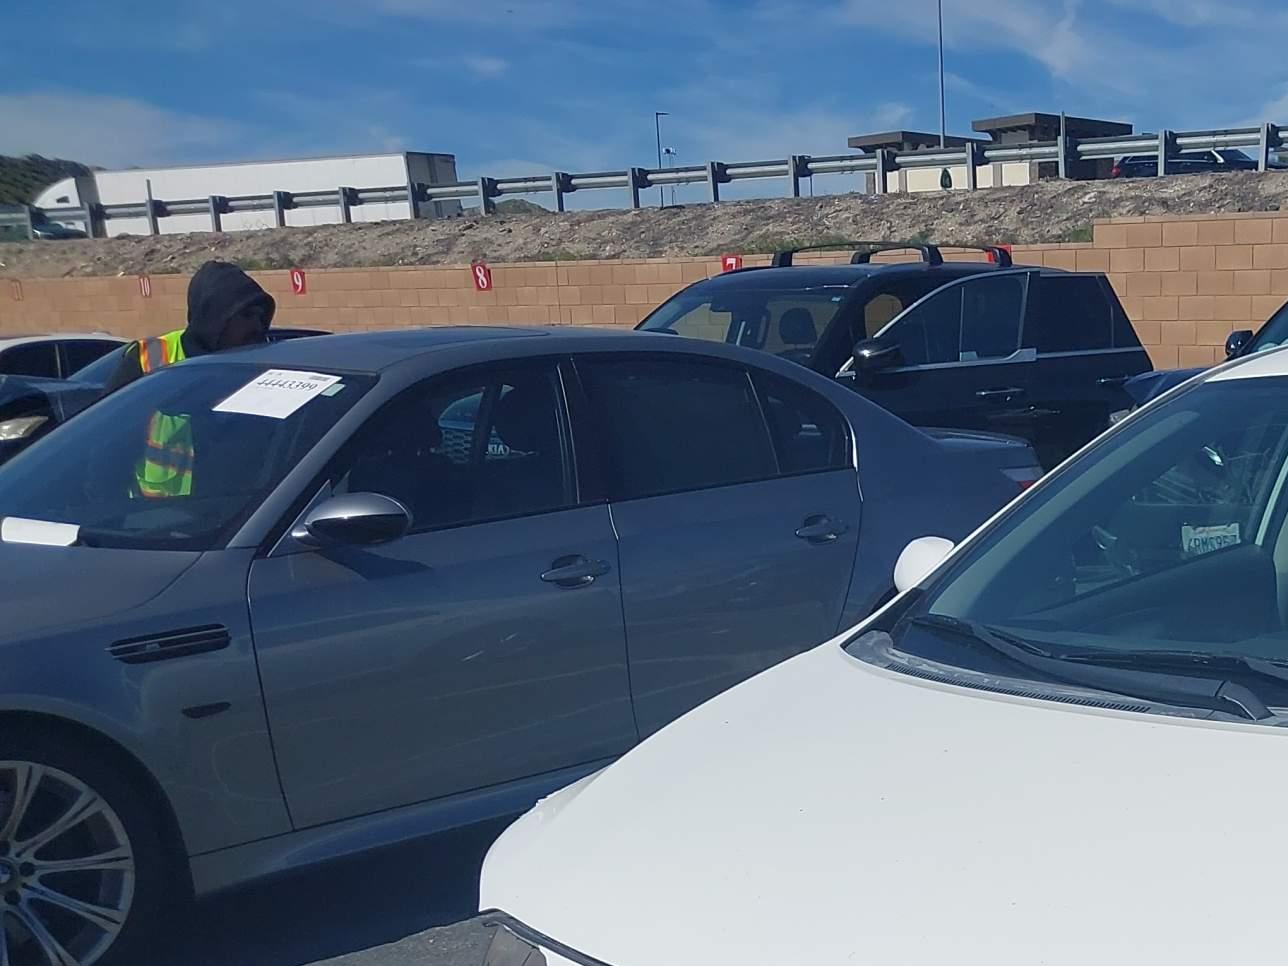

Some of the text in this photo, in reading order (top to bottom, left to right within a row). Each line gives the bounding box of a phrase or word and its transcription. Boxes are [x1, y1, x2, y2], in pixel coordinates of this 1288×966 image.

[140, 276, 151, 297] 10
[293, 271, 303, 293] 9
[475, 265, 487, 289] 8
